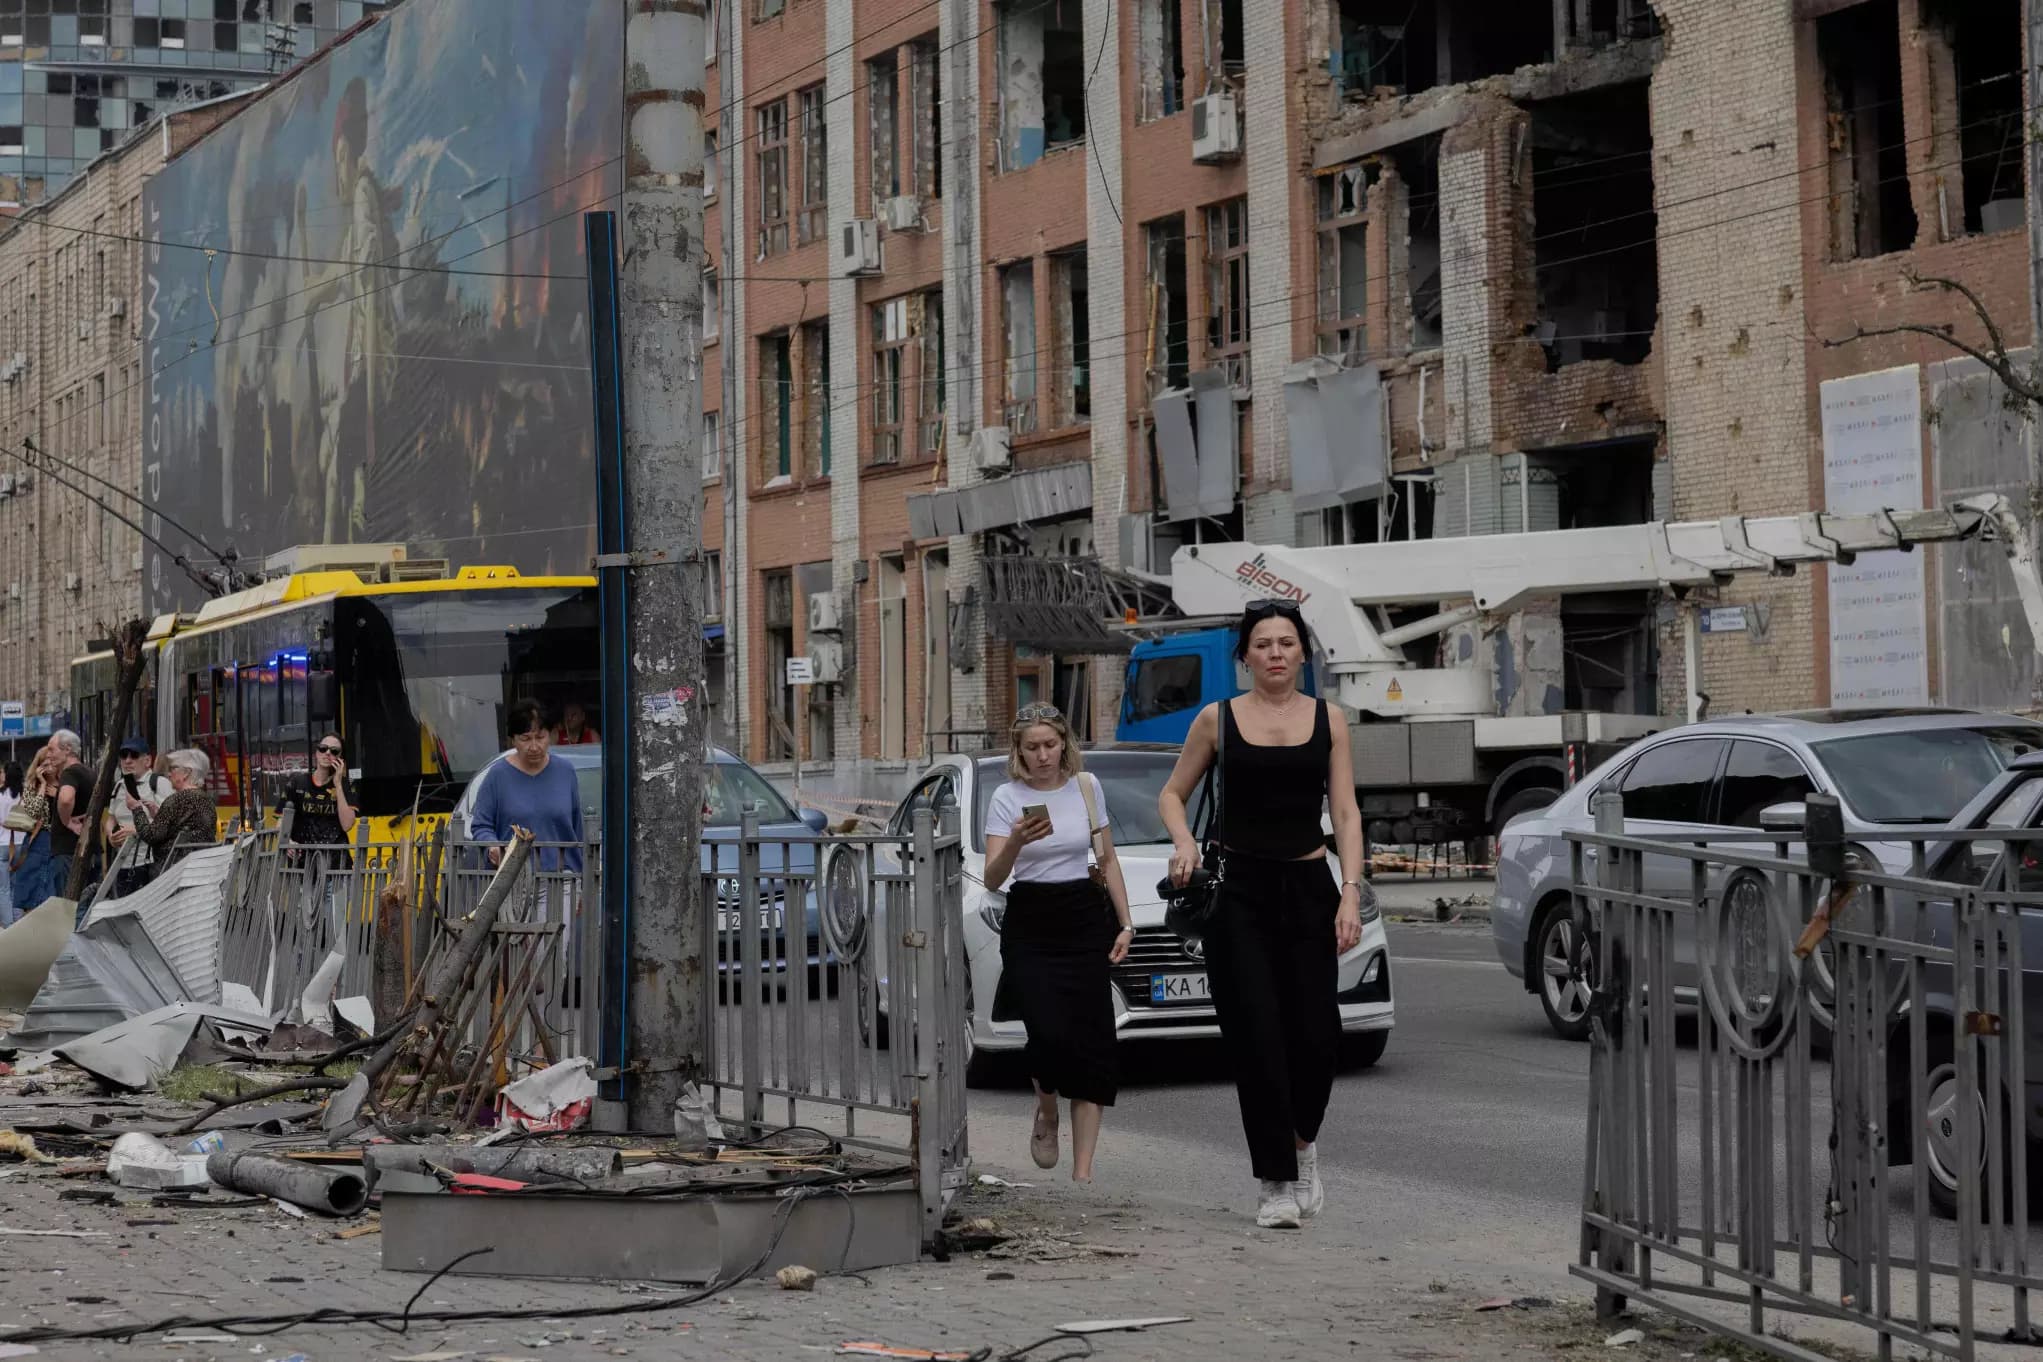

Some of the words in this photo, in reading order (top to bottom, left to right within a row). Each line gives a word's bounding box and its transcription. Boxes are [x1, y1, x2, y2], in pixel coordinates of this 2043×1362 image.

[147, 199, 161, 618] reedomWar
[1236, 560, 1311, 605] BISON
[1165, 977, 1191, 996] KA
